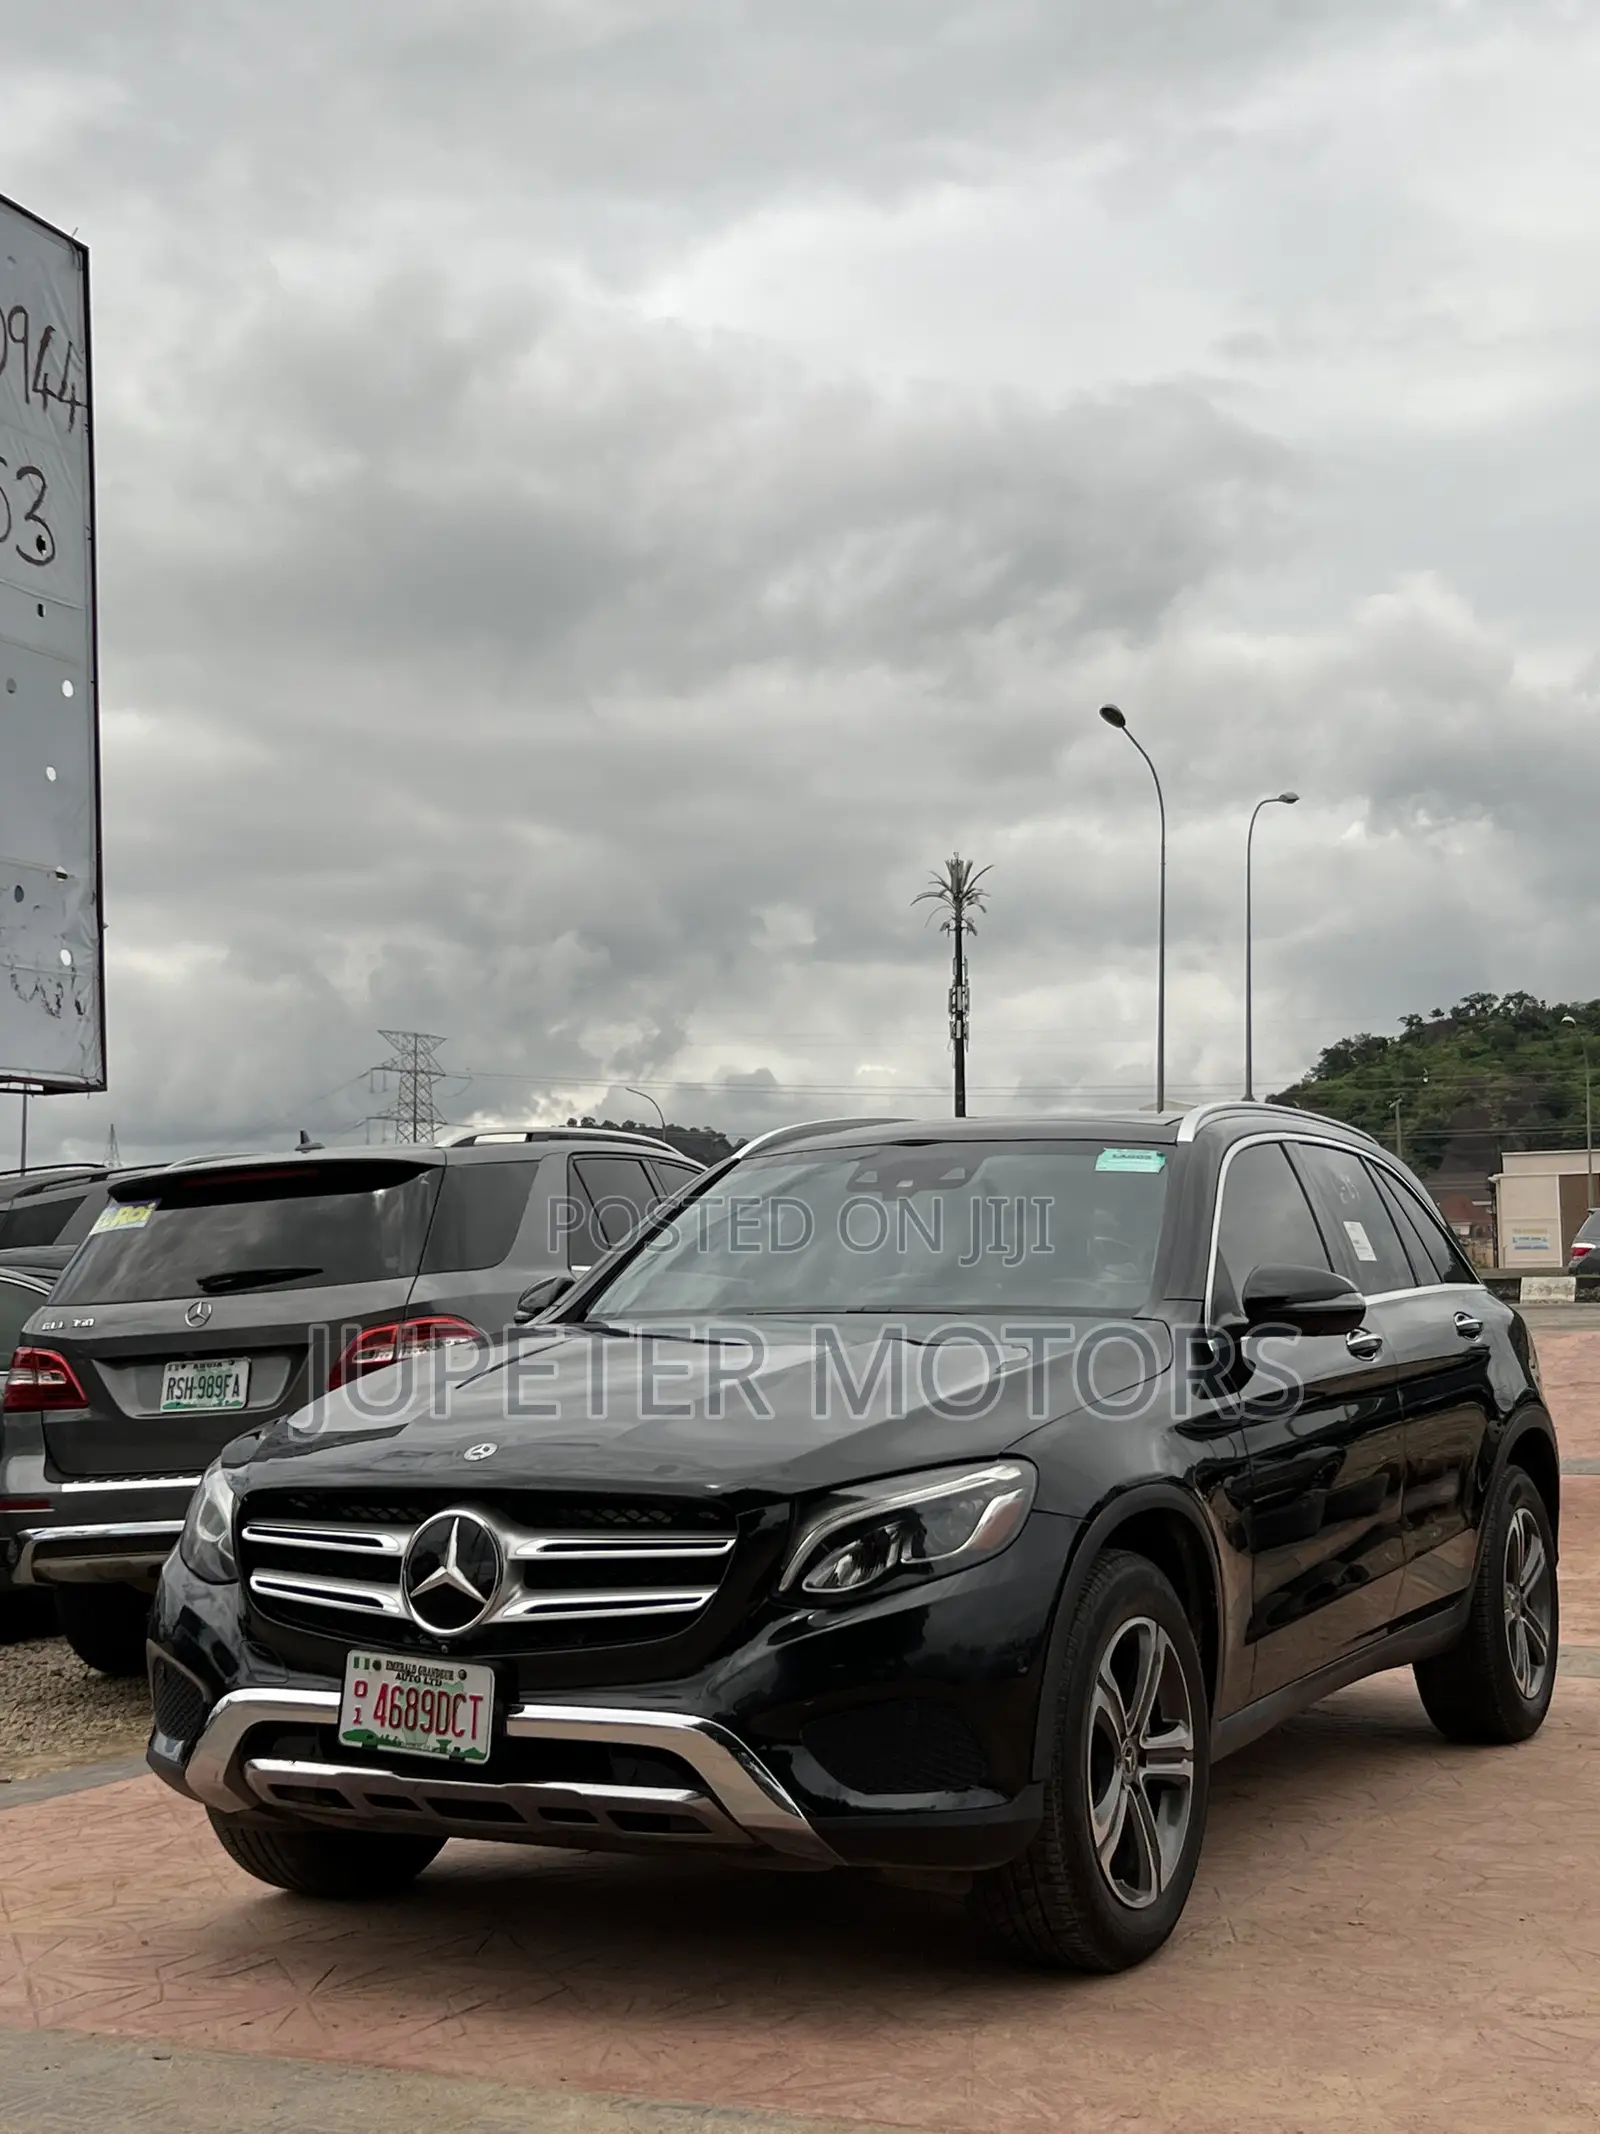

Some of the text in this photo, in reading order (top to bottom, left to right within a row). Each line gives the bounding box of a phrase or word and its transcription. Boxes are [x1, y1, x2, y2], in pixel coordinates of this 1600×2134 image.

[0, 304, 89, 435] 944
[395, 1671, 442, 1686] AUTO LTD
[373, 1682, 484, 1740] 4689DCT
